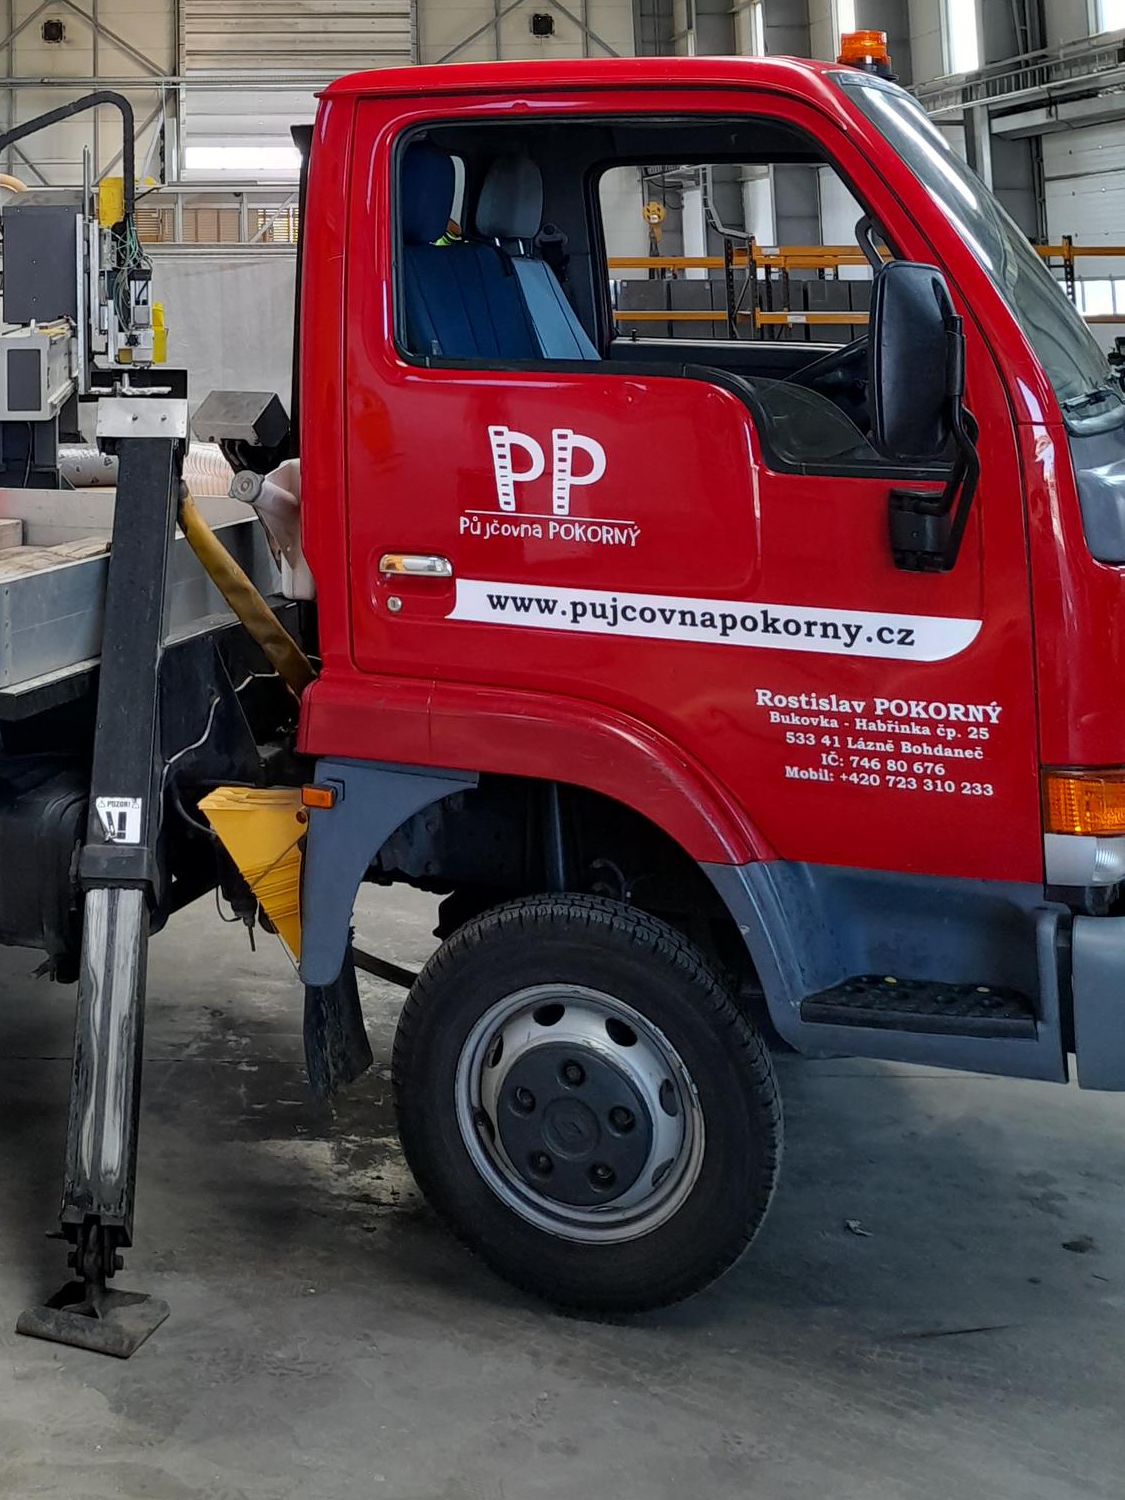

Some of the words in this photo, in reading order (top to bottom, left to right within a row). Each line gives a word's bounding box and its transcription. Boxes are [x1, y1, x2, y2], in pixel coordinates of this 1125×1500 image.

[488, 426, 606, 515] PP
[549, 521, 641, 546] POKORNÝ
[486, 593, 915, 647] www.pujcovnapokorny.cz
[756, 689, 866, 714] Rostislav
[874, 698, 1002, 723] POKORNÝ
[770, 711, 838, 728] Bukovka
[855, 718, 931, 735] Habřinka
[937, 724, 961, 740] čp.
[968, 727, 989, 739] 25
[786, 732, 815, 745] 533
[821, 735, 840, 747] 41
[847, 737, 894, 752] Lázně
[901, 742, 983, 759] Bohdaneč
[821, 752, 844, 766] IČ:
[850, 756, 881, 770] 746
[887, 760, 907, 772] 80
[913, 763, 945, 775] 676
[785, 766, 834, 781] Mobil:
[839, 773, 880, 786] +420
[886, 776, 917, 789] 723
[923, 780, 955, 792] 310
[961, 783, 993, 796] 233
